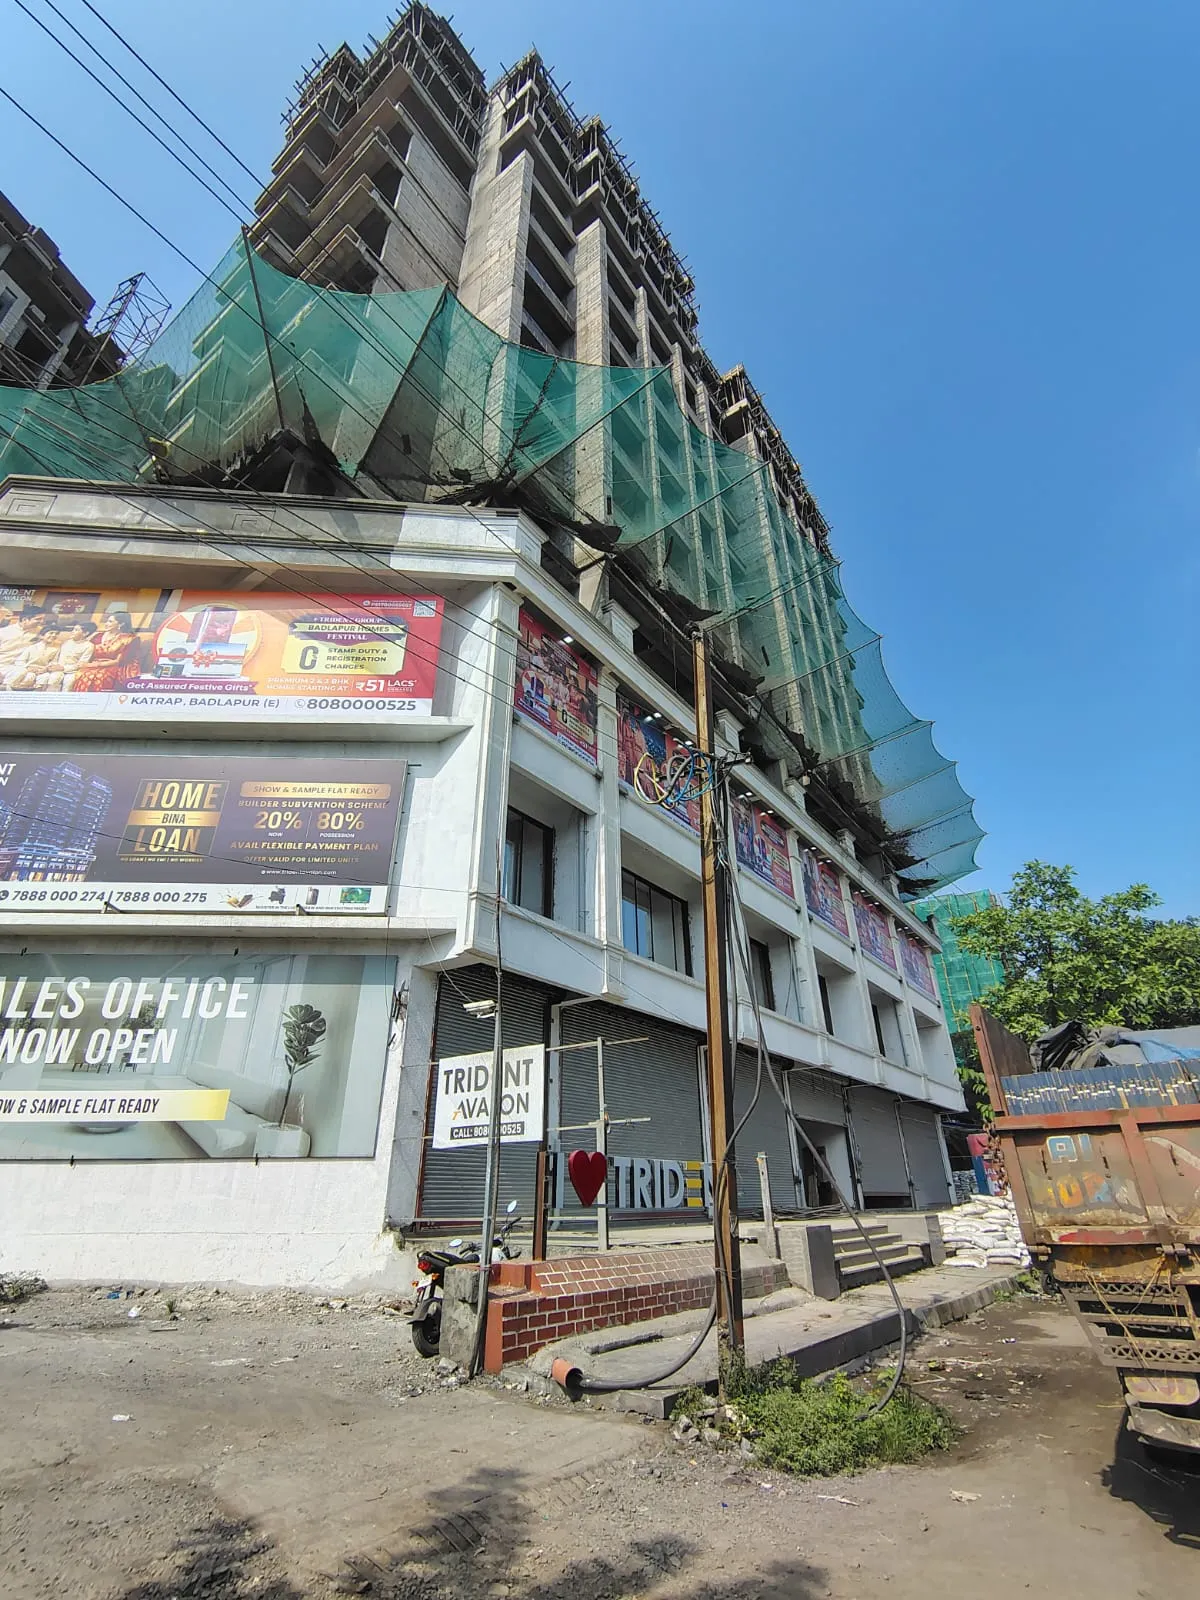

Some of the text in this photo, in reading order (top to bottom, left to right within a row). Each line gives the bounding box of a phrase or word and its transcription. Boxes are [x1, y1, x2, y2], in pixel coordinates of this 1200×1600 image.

[131, 697, 280, 709] KATRAP, BADLAPUR (E)
[306, 698, 416, 710] 8080000525
[140, 782, 222, 808] HOME
[282, 800, 345, 808] SUBVENTION
[162, 813, 186, 824] BINA
[254, 811, 364, 830] 20% 80%
[134, 828, 200, 852] LOAN
[12, 890, 208, 903] 7888 000 274 7888 000 275
[102, 976, 254, 1019] OFFICE
[0, 1028, 178, 1064] NOW OPEN
[444, 1058, 534, 1095] TRIDNT
[18, 1099, 26, 1114] &
[30, 1099, 81, 1114] SAMPLE
[84, 1099, 116, 1114] FLAT
[118, 1098, 160, 1114] READY
[452, 1092, 529, 1120] AVAON
[453, 1124, 522, 1138] CALL: 8080525
